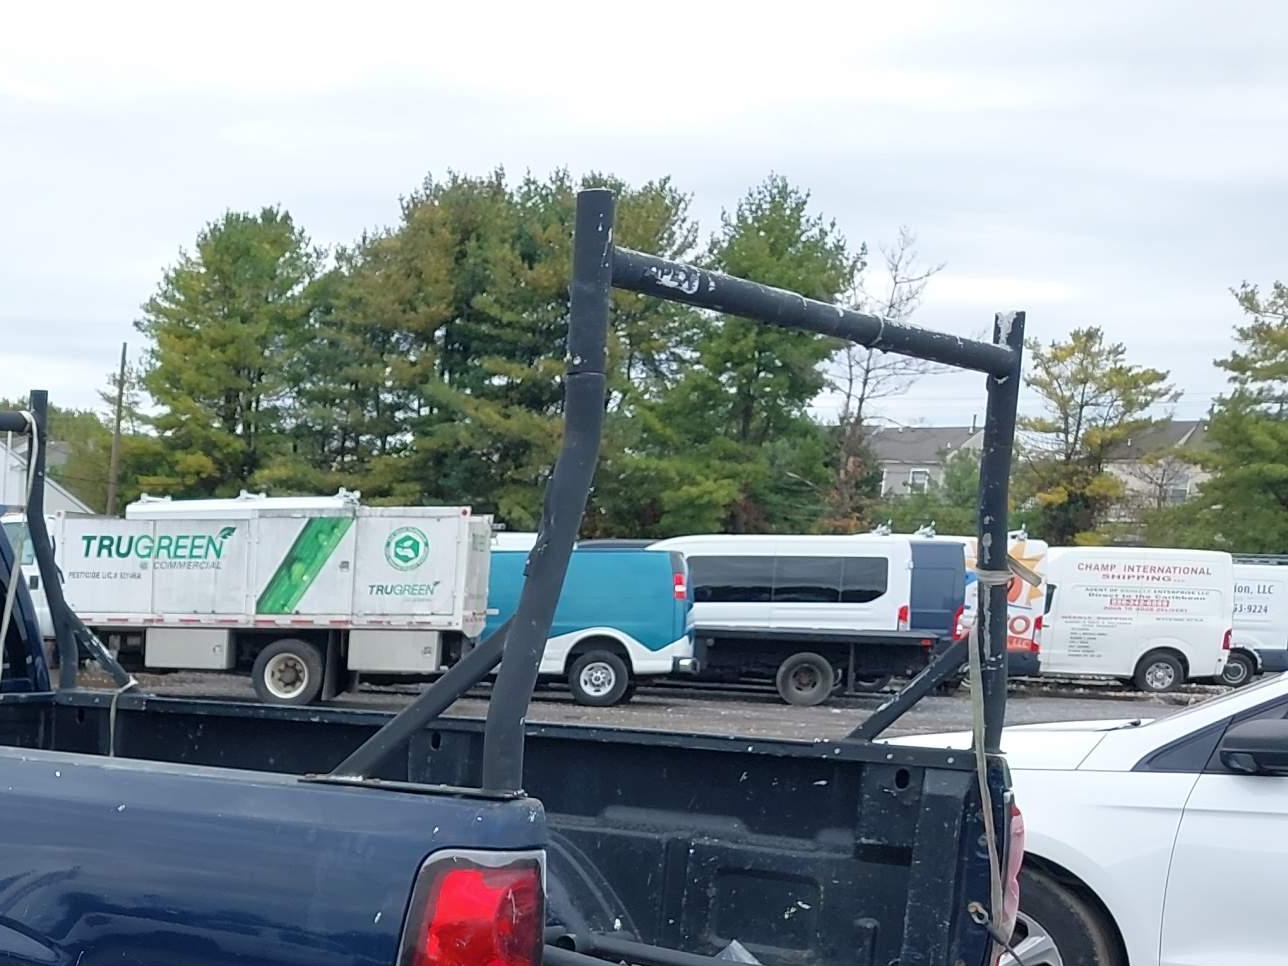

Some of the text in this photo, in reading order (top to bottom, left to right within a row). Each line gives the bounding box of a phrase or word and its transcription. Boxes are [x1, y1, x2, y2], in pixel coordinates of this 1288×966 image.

[82, 535, 224, 559] TRUGREEN
[153, 561, 222, 570] COMMERCIAL
[1077, 562, 1212, 575] CHAMP INTERNATIONAL
[1102, 573, 1172, 582] SHIPPING
[368, 584, 434, 595] TRUGREEN
[1257, 584, 1274, 594] LLC
